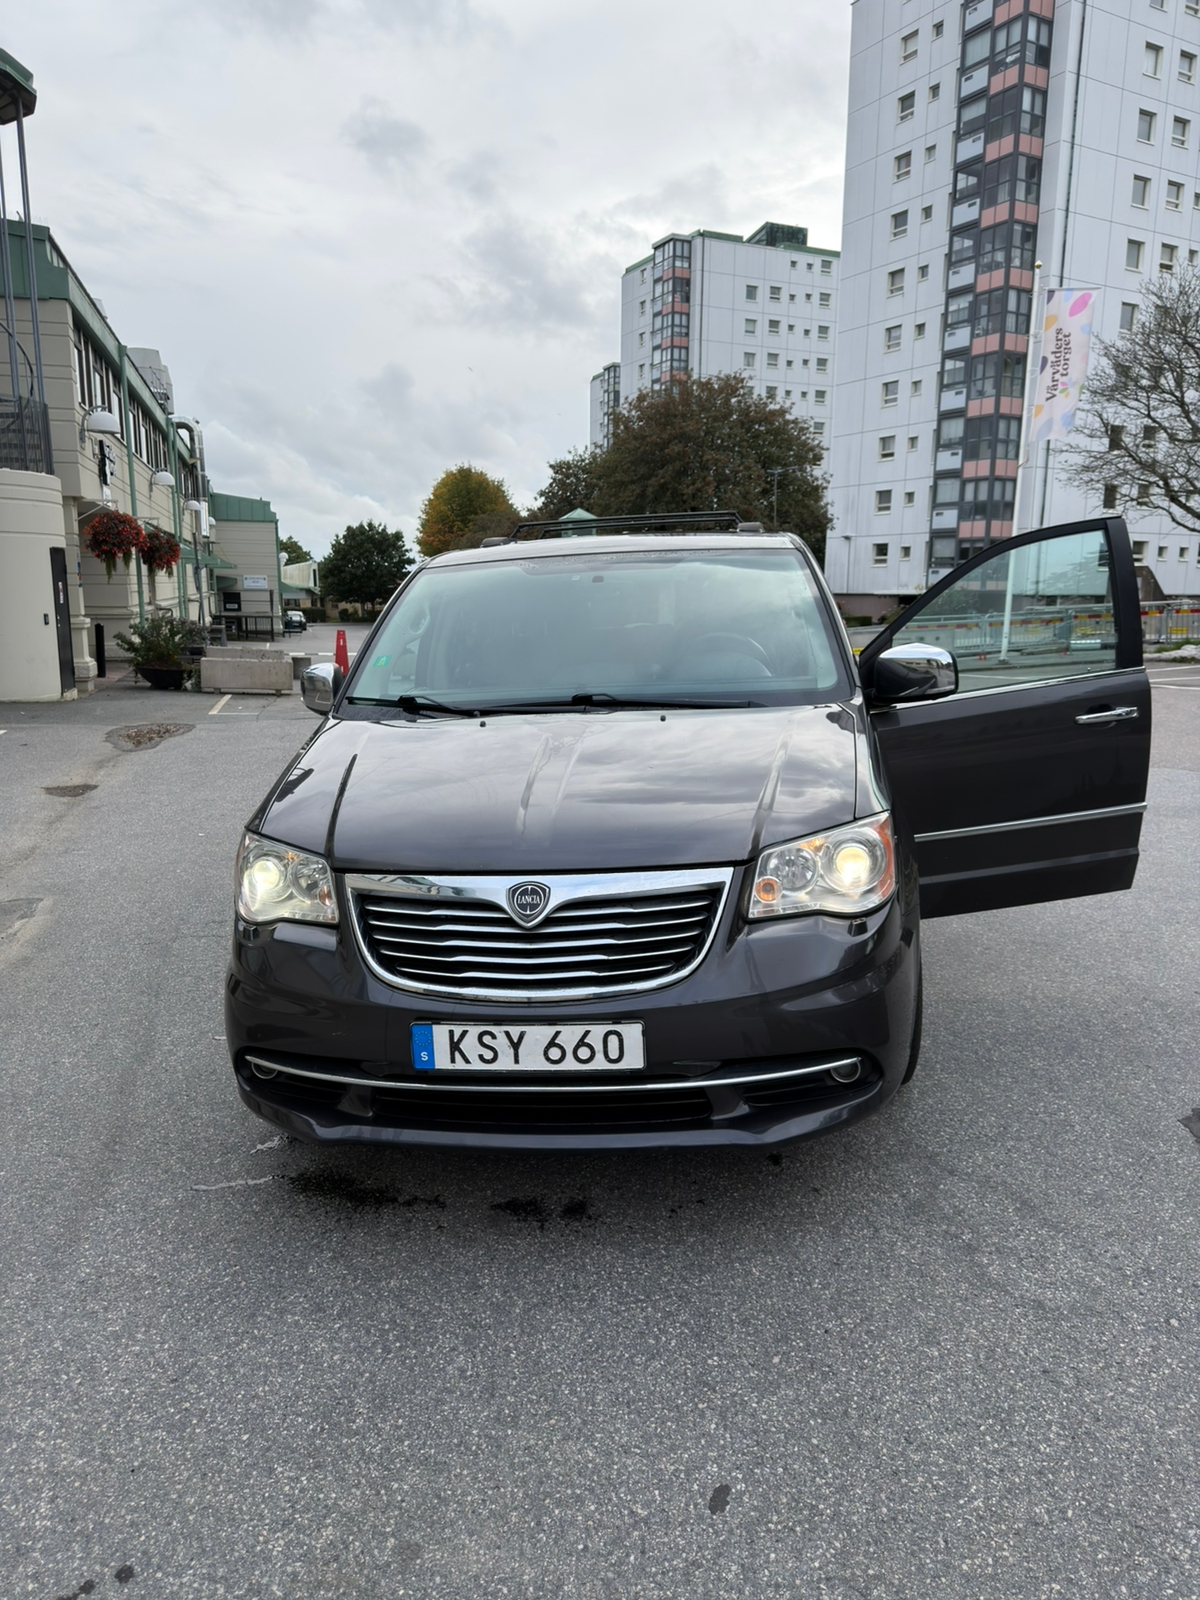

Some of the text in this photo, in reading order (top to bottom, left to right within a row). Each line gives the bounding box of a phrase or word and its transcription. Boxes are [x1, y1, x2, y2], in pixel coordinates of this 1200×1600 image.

[1045, 327, 1063, 402] Vårväders
[1060, 332, 1072, 378] torget
[517, 895, 541, 904] LANCIA
[420, 1051, 429, 1061] S
[448, 1029, 625, 1065] KSY 660
